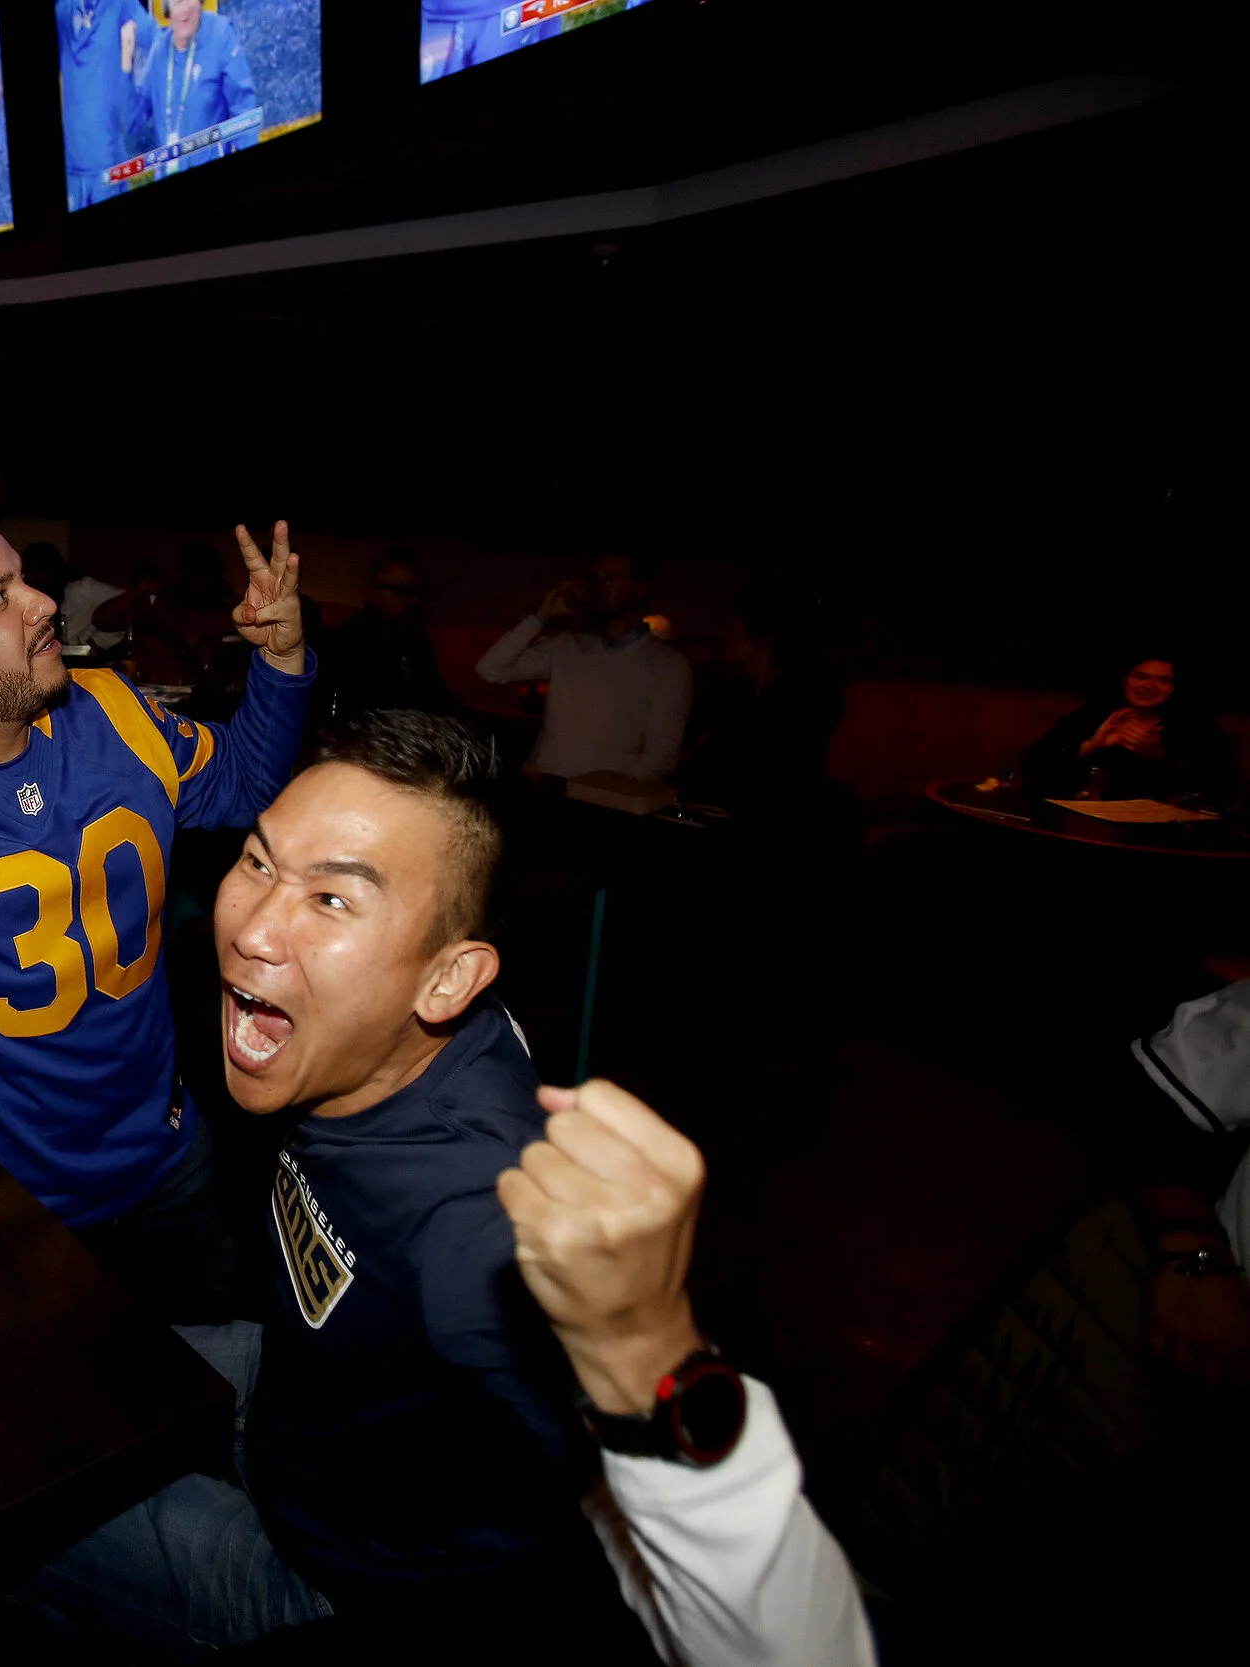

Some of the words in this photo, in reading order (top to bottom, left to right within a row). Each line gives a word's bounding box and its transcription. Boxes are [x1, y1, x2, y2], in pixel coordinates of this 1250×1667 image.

[22, 795, 40, 811] NFL
[276, 1168, 342, 1305] AMS
[282, 1150, 298, 1173] OS
[300, 1172, 356, 1268] ANGELES
